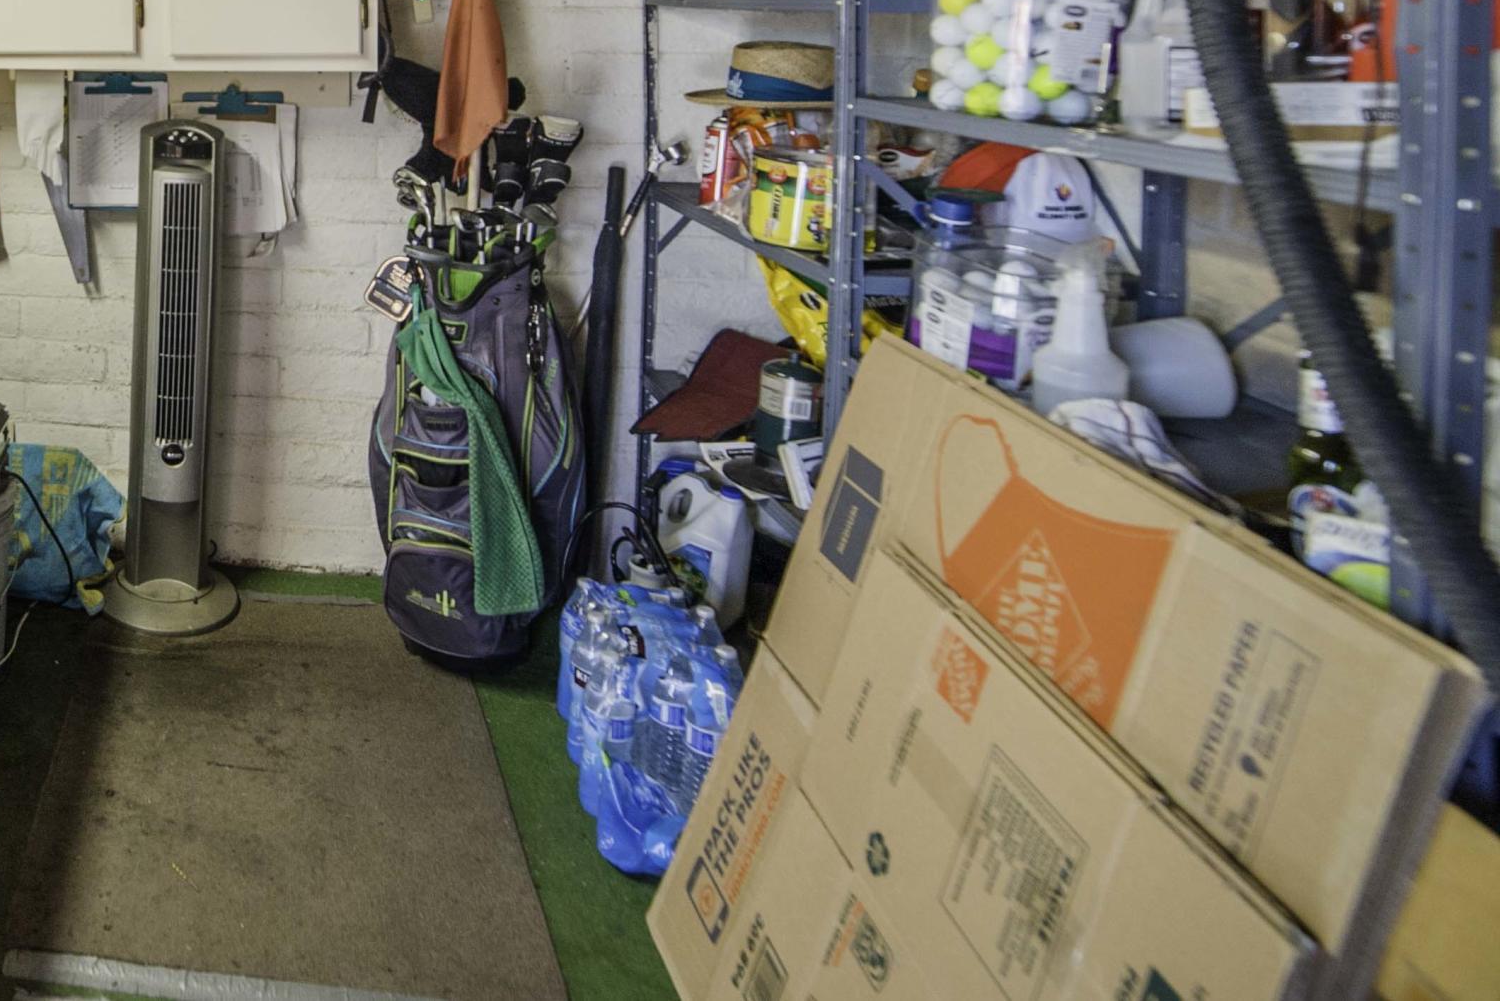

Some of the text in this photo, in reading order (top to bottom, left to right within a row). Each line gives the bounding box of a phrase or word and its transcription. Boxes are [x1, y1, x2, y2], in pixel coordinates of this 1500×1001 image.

[1190, 619, 1260, 795] RECYCLED PAPER
[703, 731, 763, 862] PACK LIKE
[713, 749, 772, 878] THE PROS
